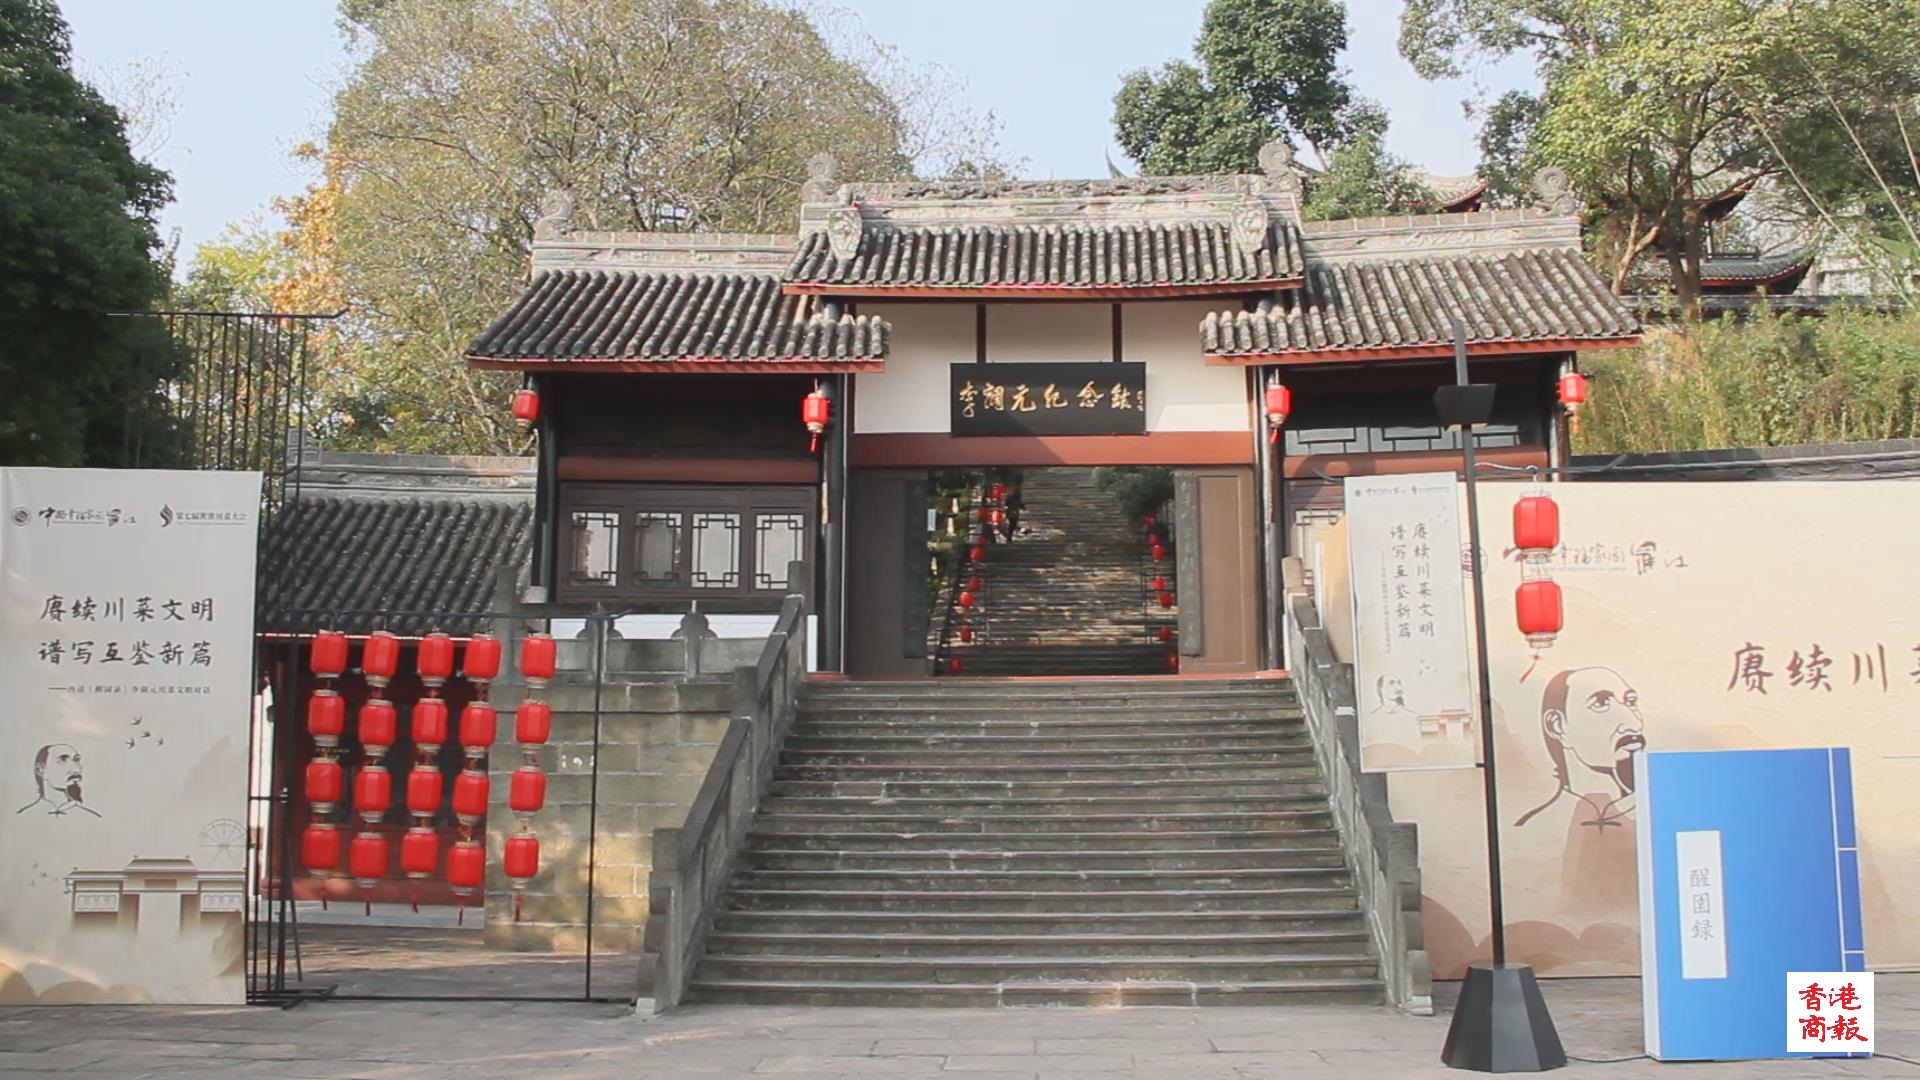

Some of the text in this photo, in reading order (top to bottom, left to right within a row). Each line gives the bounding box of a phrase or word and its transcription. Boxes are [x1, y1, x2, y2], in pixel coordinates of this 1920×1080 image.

[40, 594, 214, 622] 赓续川菜文明
[1390, 523, 1411, 639] 谱写互鉴新篇
[1412, 522, 1435, 637] 赓续川菜文明
[38, 639, 212, 667] 谱写互鉴新篇
